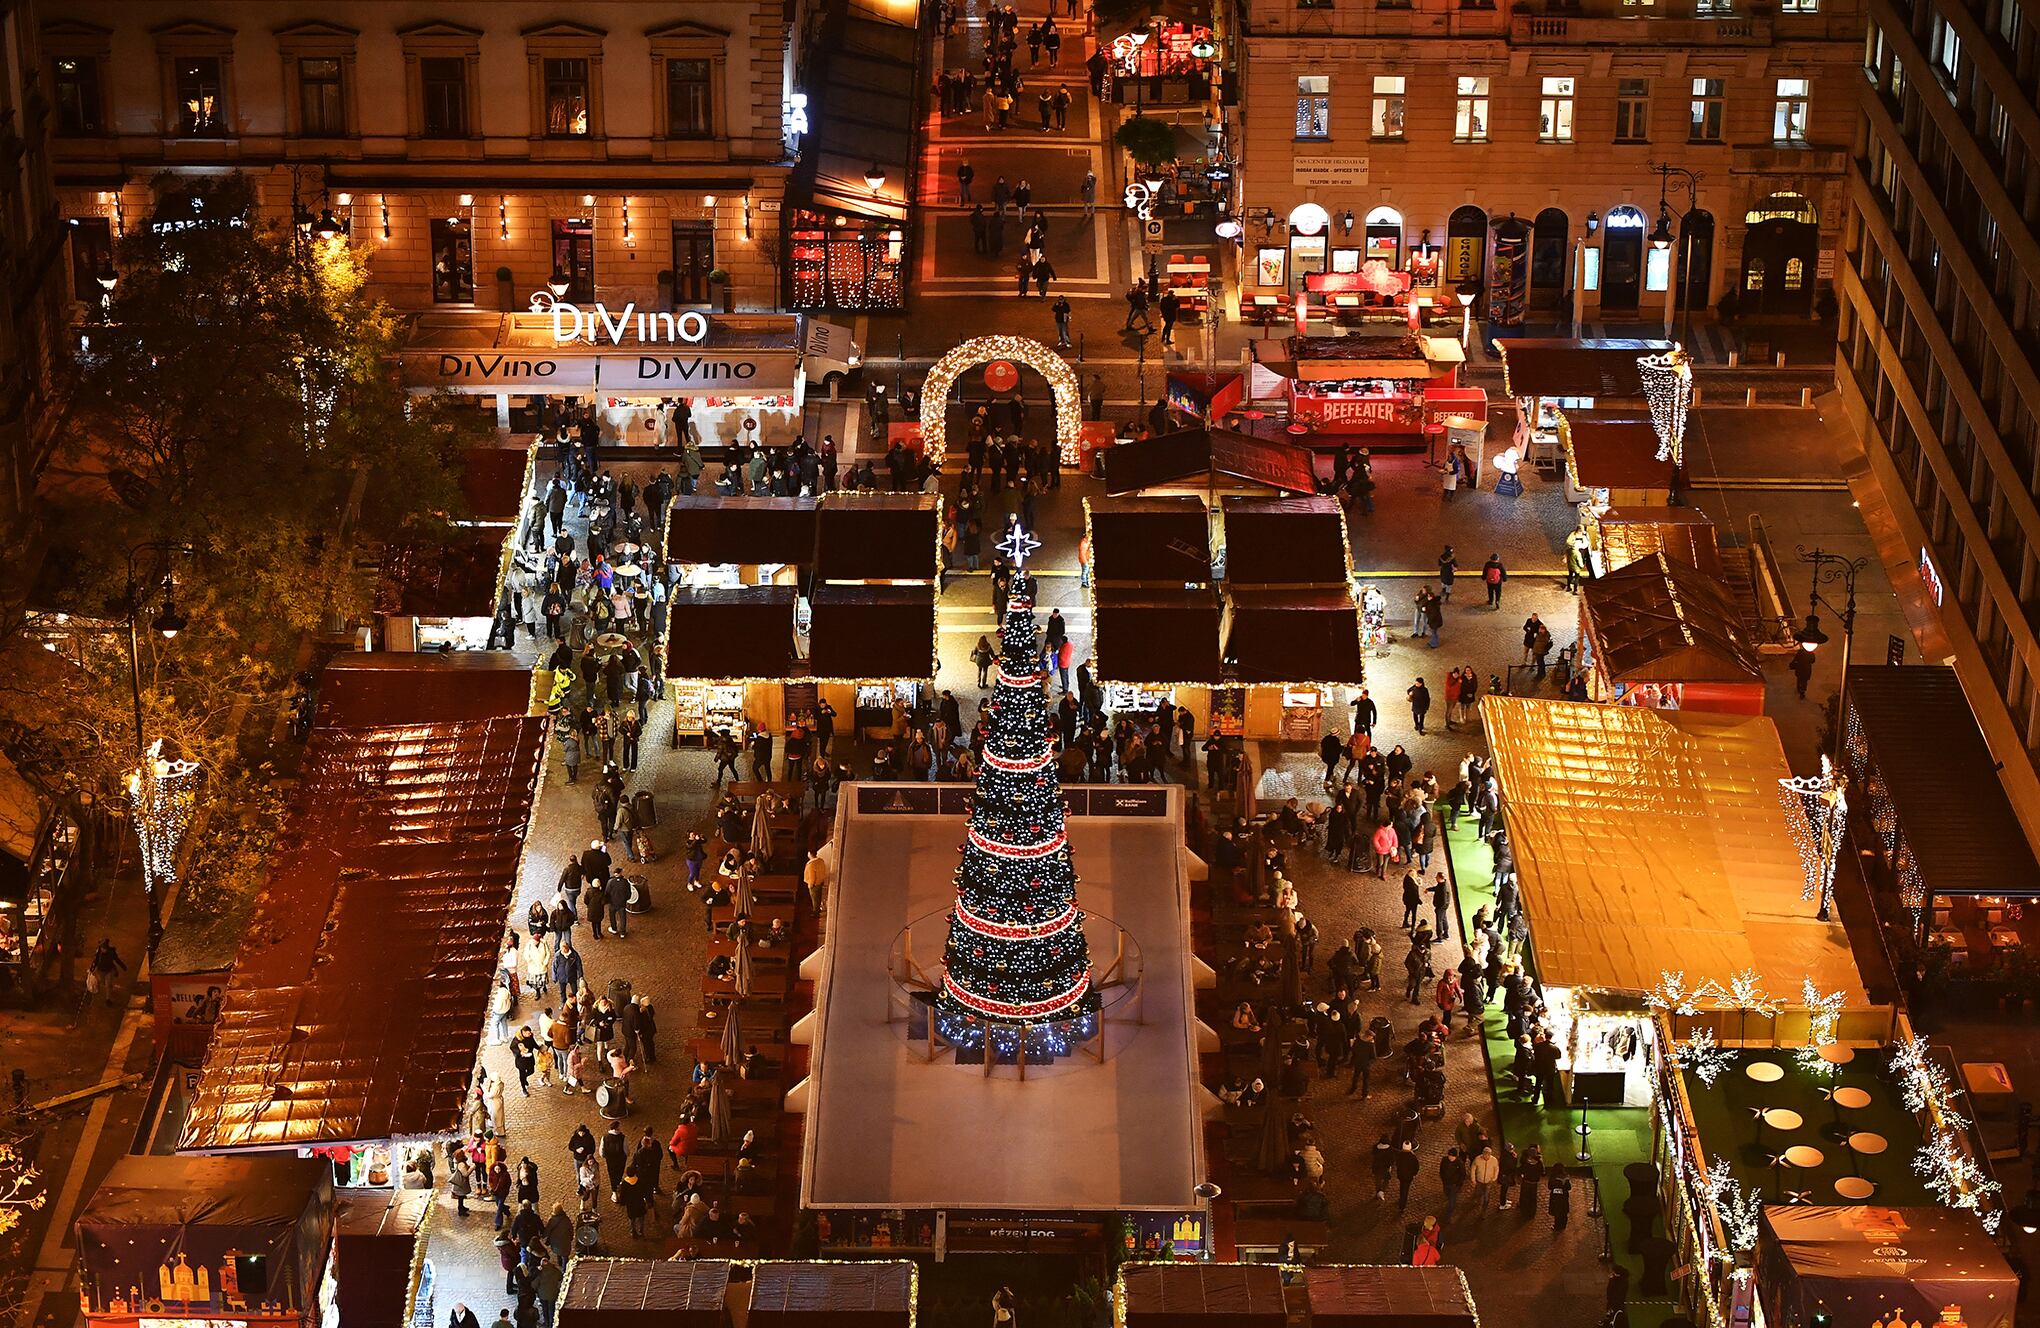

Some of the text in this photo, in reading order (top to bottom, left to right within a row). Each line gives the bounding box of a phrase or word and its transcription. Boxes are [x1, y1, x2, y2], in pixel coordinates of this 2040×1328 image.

[1460, 238, 1471, 274] CHANGE
[552, 302, 708, 346] DiVino
[438, 354, 557, 378] DiVino
[638, 356, 756, 381] DiVino
[1323, 402, 1395, 423] BEEFEATER
